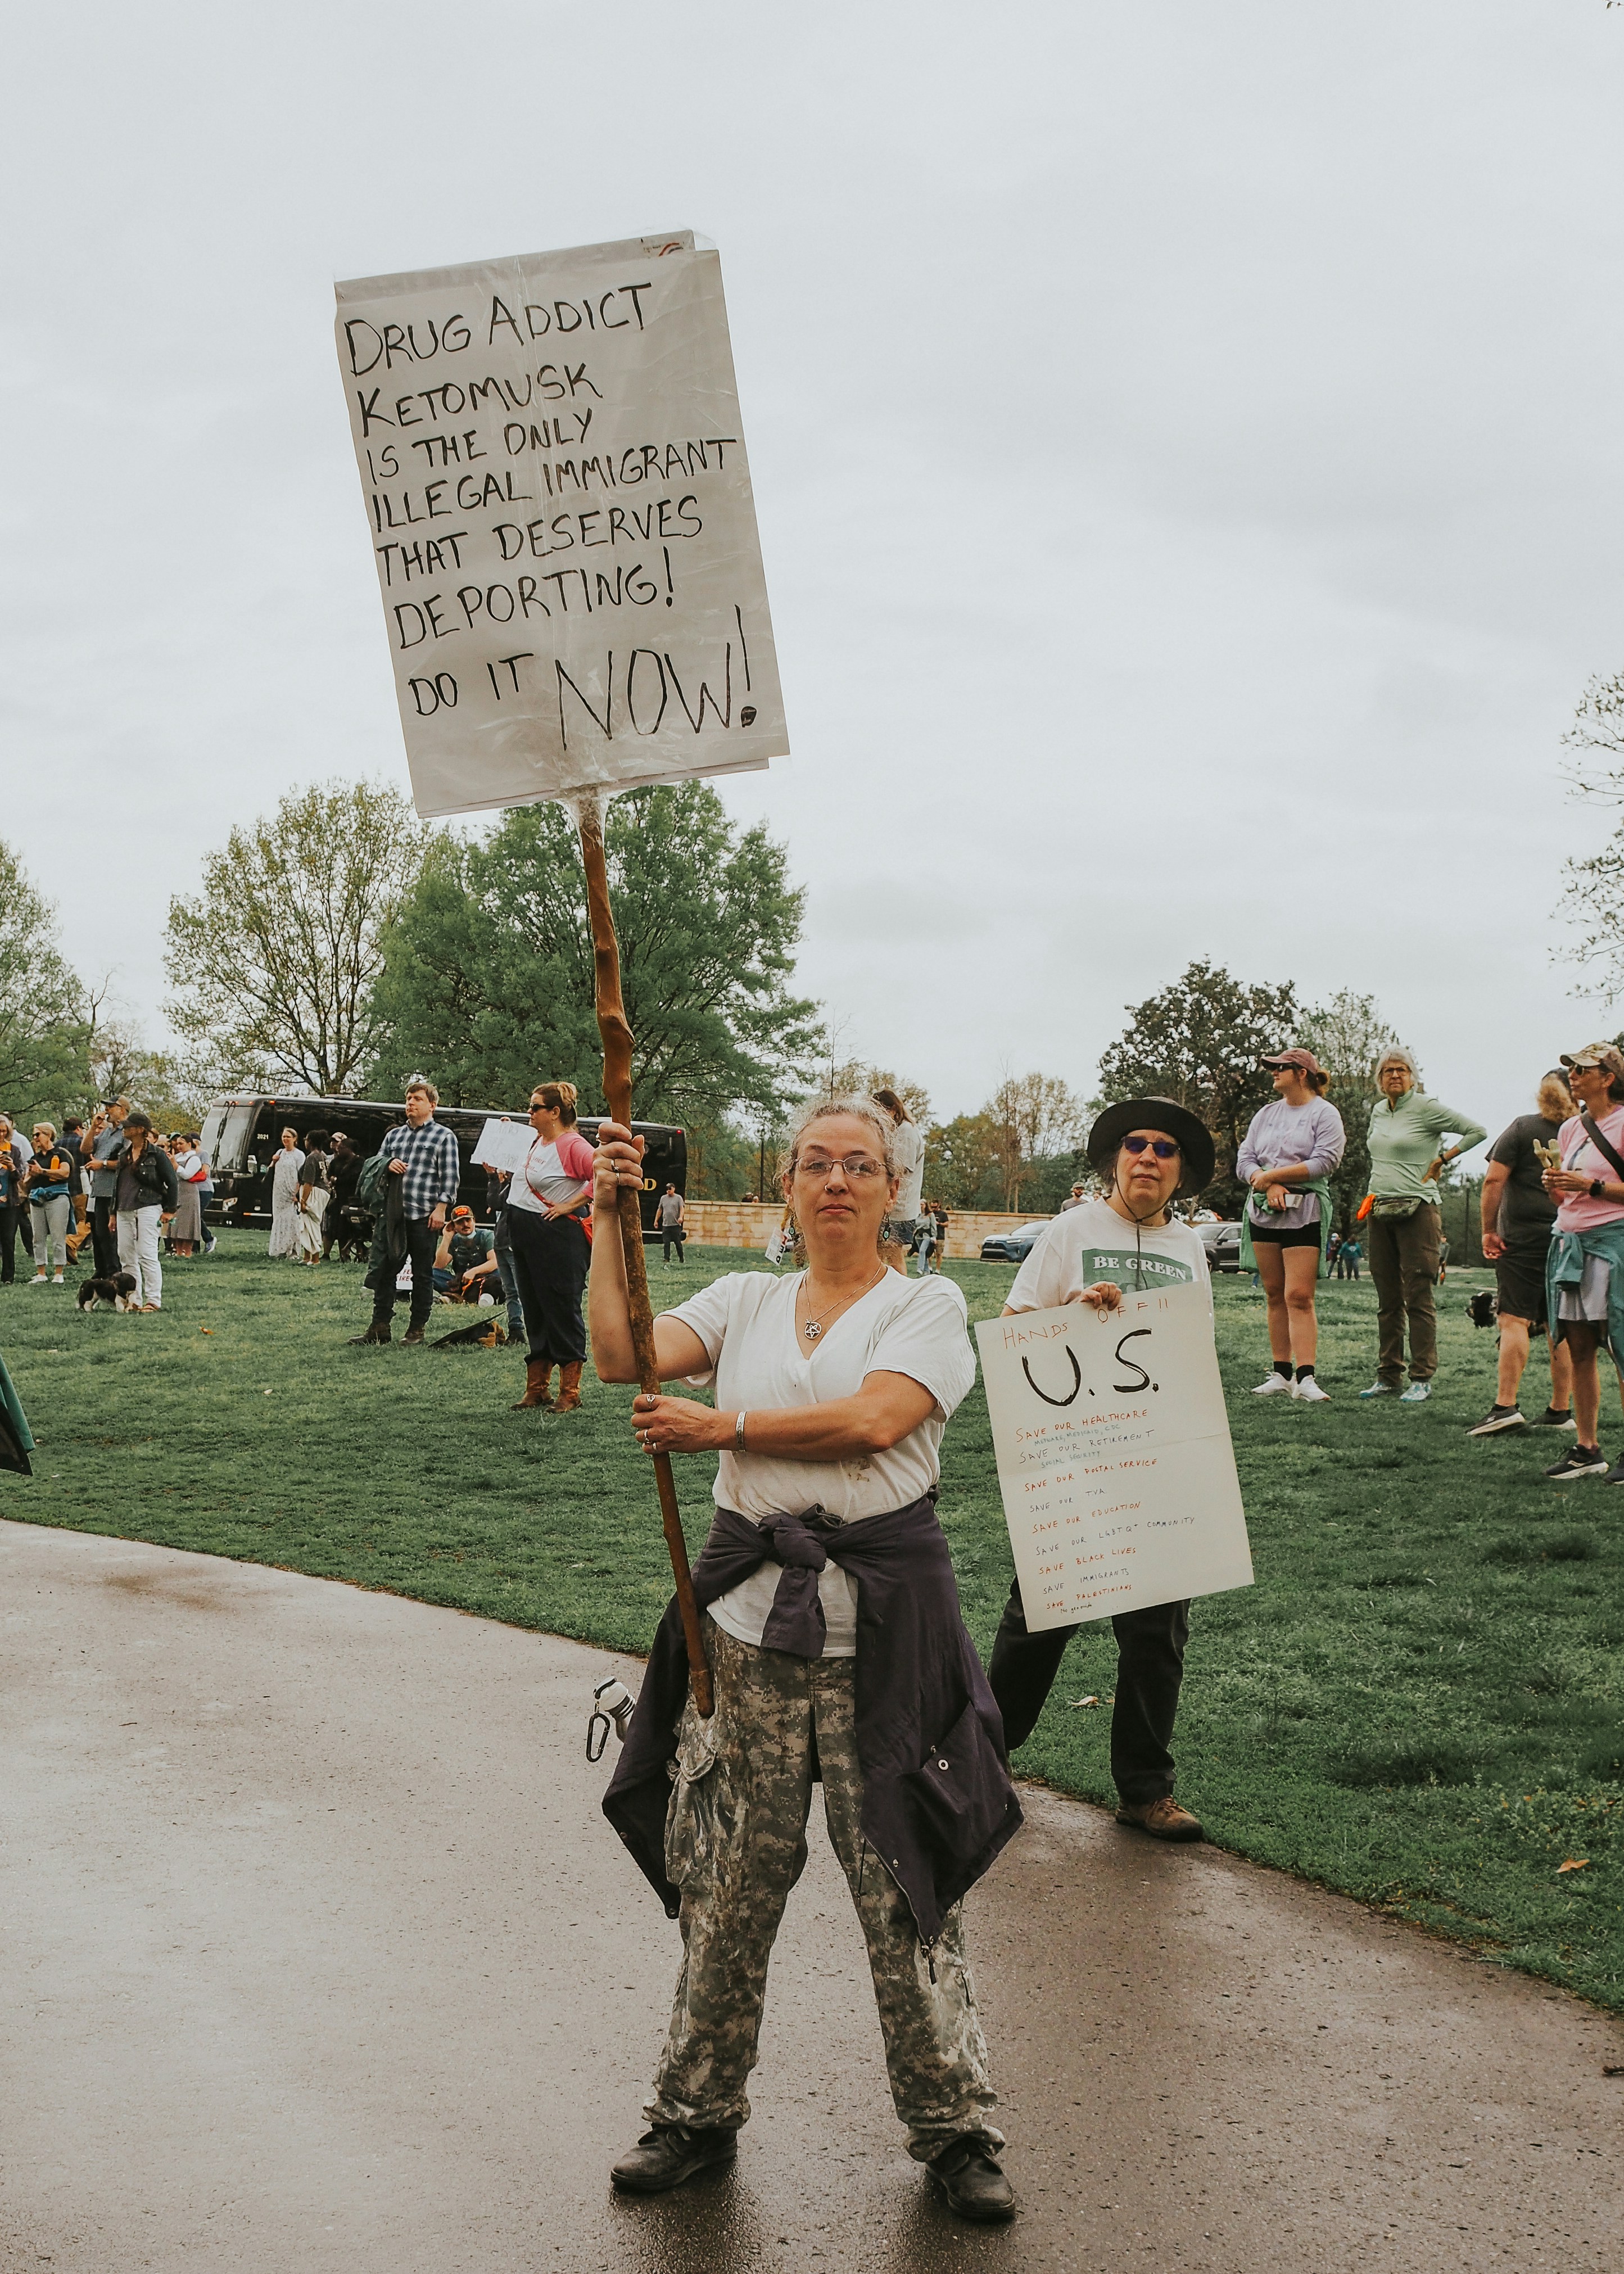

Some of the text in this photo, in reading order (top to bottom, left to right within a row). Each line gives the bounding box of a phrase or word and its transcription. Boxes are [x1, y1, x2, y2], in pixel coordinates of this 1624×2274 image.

[344, 282, 652, 377] DRUG ADDICT
[357, 363, 603, 438] KETOMUSK
[368, 408, 593, 485] IS THE ONLY
[371, 439, 737, 533] ILLEGAL IMMIGRANT
[376, 495, 703, 586] THAT DESERVES
[393, 546, 674, 649] DEPORTING!
[408, 604, 758, 751] DO IT NOW!
[1093, 1256, 1186, 1280] BE GREEN
[1003, 1322, 1068, 1349] HANDS
[1021, 1327, 1159, 1407] U.S.
[1016, 1409, 1148, 1443] SAVE OUR HEALTHCARE
[1019, 1429, 1155, 1464] SAVE OUR RETIREMENT
[1041, 1450, 1101, 1469] SOCIAL SECURITY
[1025, 1458, 1157, 1492] SAVE OUR POSTAL SERVICE
[1030, 1502, 1051, 1513] SAVE
[1032, 1501, 1141, 1534] SAVE OUR EDUCATION
[1036, 1517, 1195, 1556] SAVE OUR LGBTQ+ COMMUNITY
[1039, 1547, 1137, 1575] SAVE BLACK LIVES
[1043, 1568, 1129, 1594] SAVE IMMIGRANTS
[1046, 1584, 1132, 1610] SAVE PALESTINIANS
